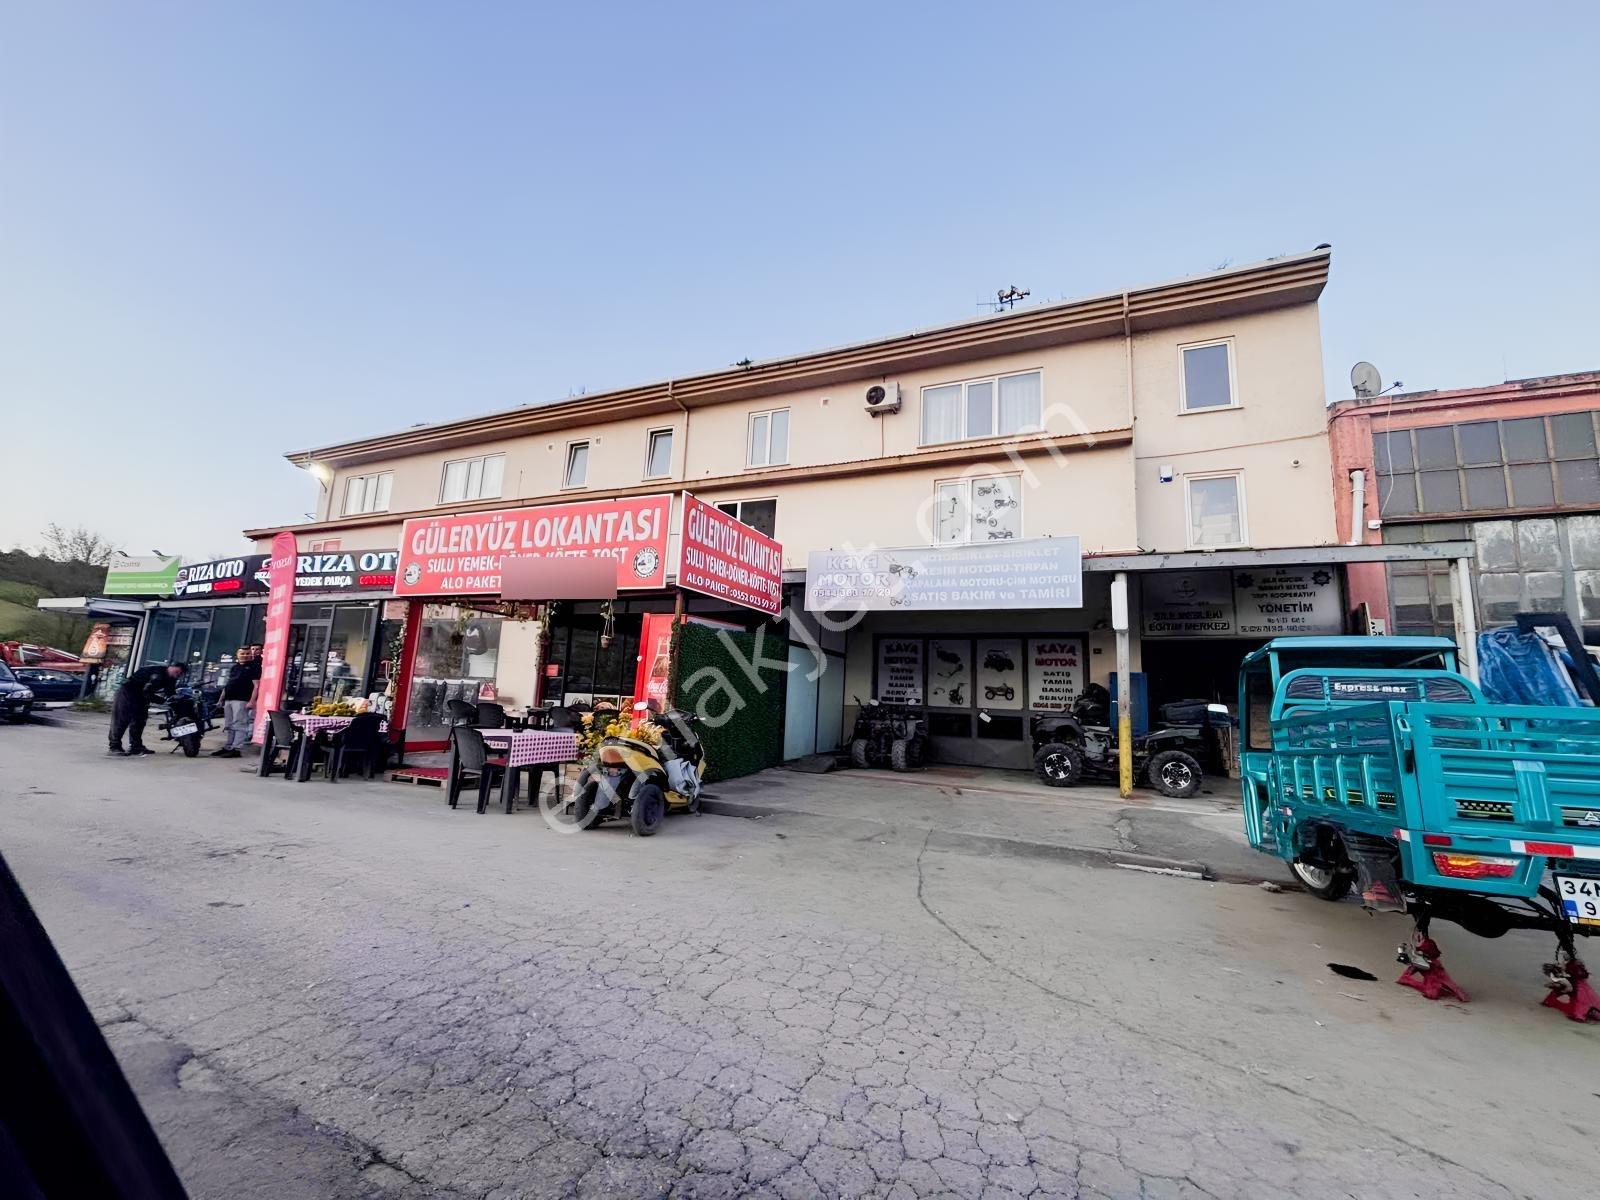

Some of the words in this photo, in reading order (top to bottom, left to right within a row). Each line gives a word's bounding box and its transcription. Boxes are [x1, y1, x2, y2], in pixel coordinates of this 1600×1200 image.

[411, 515, 517, 555] GÜLERYÜZ
[521, 507, 661, 549] LOKANTASI
[688, 505, 738, 558] GÜLERYÜZ
[739, 533, 781, 577] LOKANTASI
[296, 554, 357, 574] RIZA
[359, 552, 398, 571] OT
[427, 558, 454, 573] SULU
[686, 547, 704, 569] SULU
[827, 554, 878, 570] KAYA
[188, 564, 214, 582] RIZA
[216, 560, 244, 578] OTO
[440, 576, 463, 589] ALO
[686, 572, 704, 586] ALO
[705, 578, 729, 594] PAKET
[817, 572, 891, 587] MOTOR
[951, 590, 995, 601] BAKIM
[1021, 587, 1070, 599] TAMİRİ
[1037, 643, 1077, 656] KAYA
[1035, 657, 1077, 667] MOTOR
[1334, 682, 1380, 693] Express
